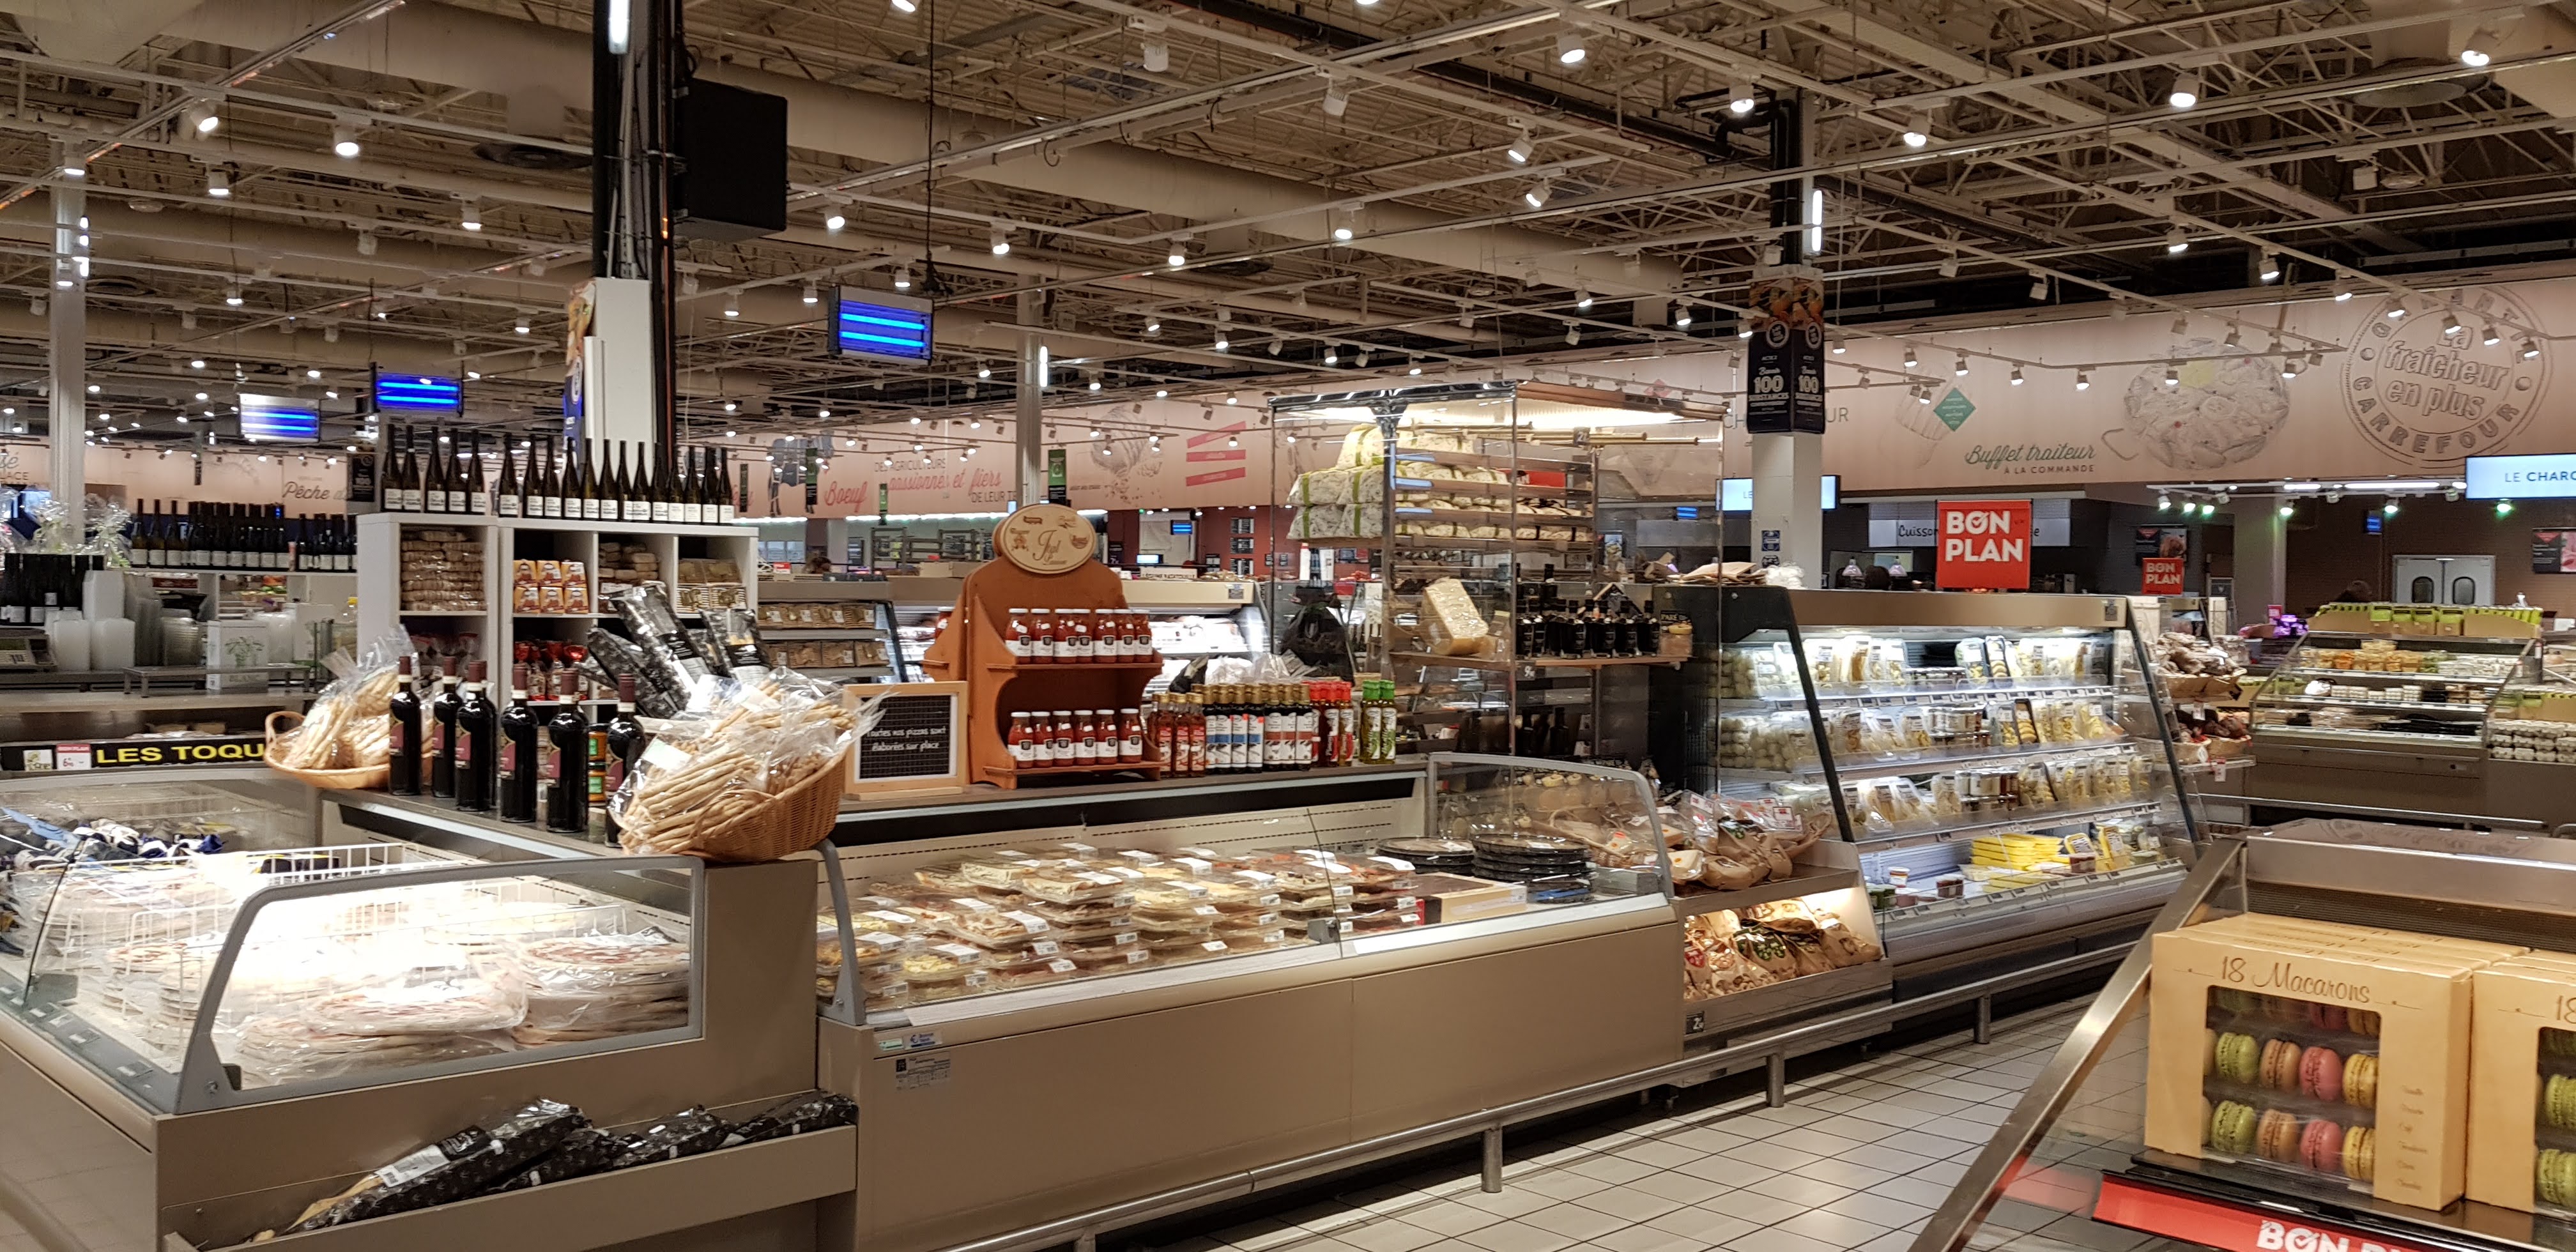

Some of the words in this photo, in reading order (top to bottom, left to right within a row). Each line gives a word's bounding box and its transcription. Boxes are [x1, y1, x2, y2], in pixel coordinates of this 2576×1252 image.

[2384, 340, 2510, 390] fraîcheur
[1753, 375, 1784, 393] 100
[1798, 375, 1820, 393] 100
[2386, 380, 2421, 407] en
[2423, 384, 2485, 420] plus
[2353, 377, 2519, 454] CARREFOUR
[1964, 445, 2024, 470] Buffet
[2025, 443, 2096, 461] traiteur
[2031, 464, 2096, 474] COMMANDE
[2504, 473, 2521, 482] LE
[282, 481, 330, 500] Pêche
[952, 468, 967, 489] et
[969, 468, 1002, 496] fiers
[971, 492, 983, 503] DE
[1946, 510, 2011, 535] BON
[1945, 538, 2023, 562] PLAN
[2147, 562, 2175, 573] BON
[2145, 574, 2181, 584] PLAN
[907, 728, 928, 738] pizzas
[920, 740, 940, 752] place
[96, 747, 161, 764] LES
[2221, 956, 2246, 982] 18
[2253, 962, 2370, 1004] Macarons
[2257, 1219, 2350, 1252] BON
